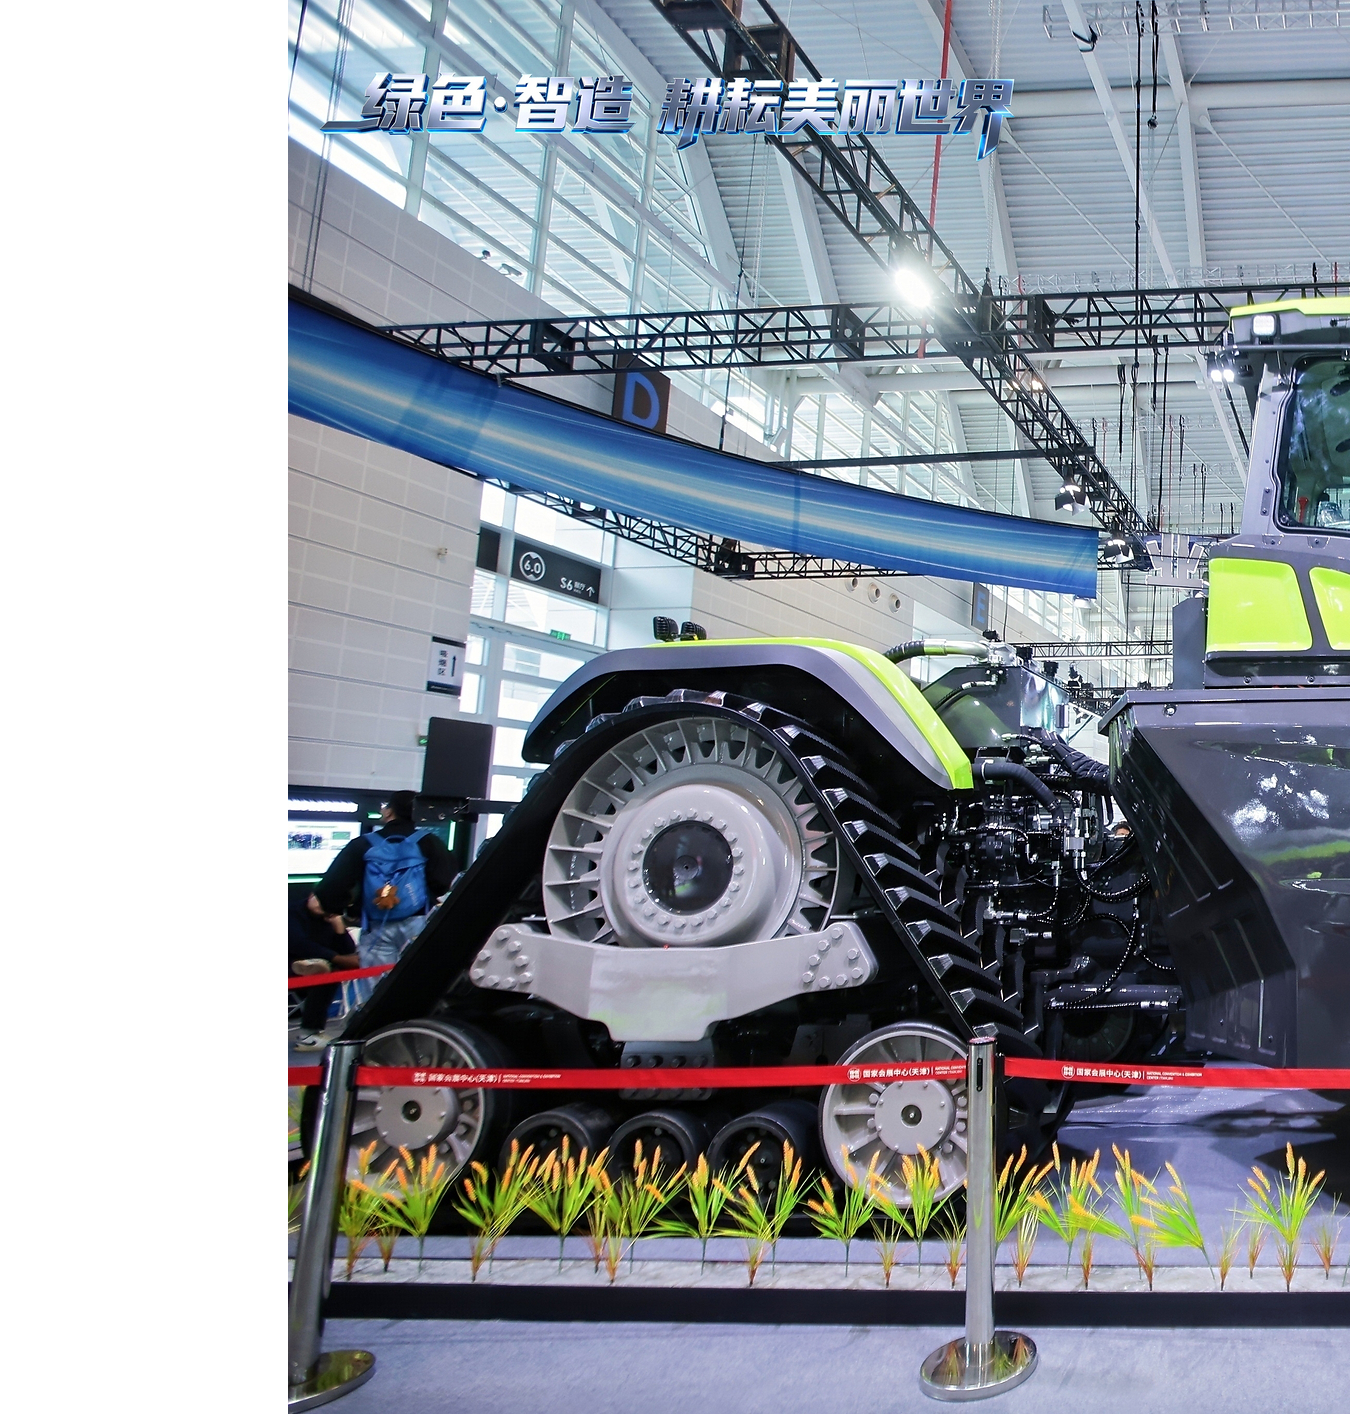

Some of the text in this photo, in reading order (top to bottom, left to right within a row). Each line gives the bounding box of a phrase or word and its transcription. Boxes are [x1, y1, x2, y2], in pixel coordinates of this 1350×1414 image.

[623, 372, 660, 430] D
[524, 559, 541, 574] 6.0
[560, 577, 574, 591] S6
[977, 591, 986, 624] E
[1077, 1067, 1142, 1079] 国家会展中心(天津)
